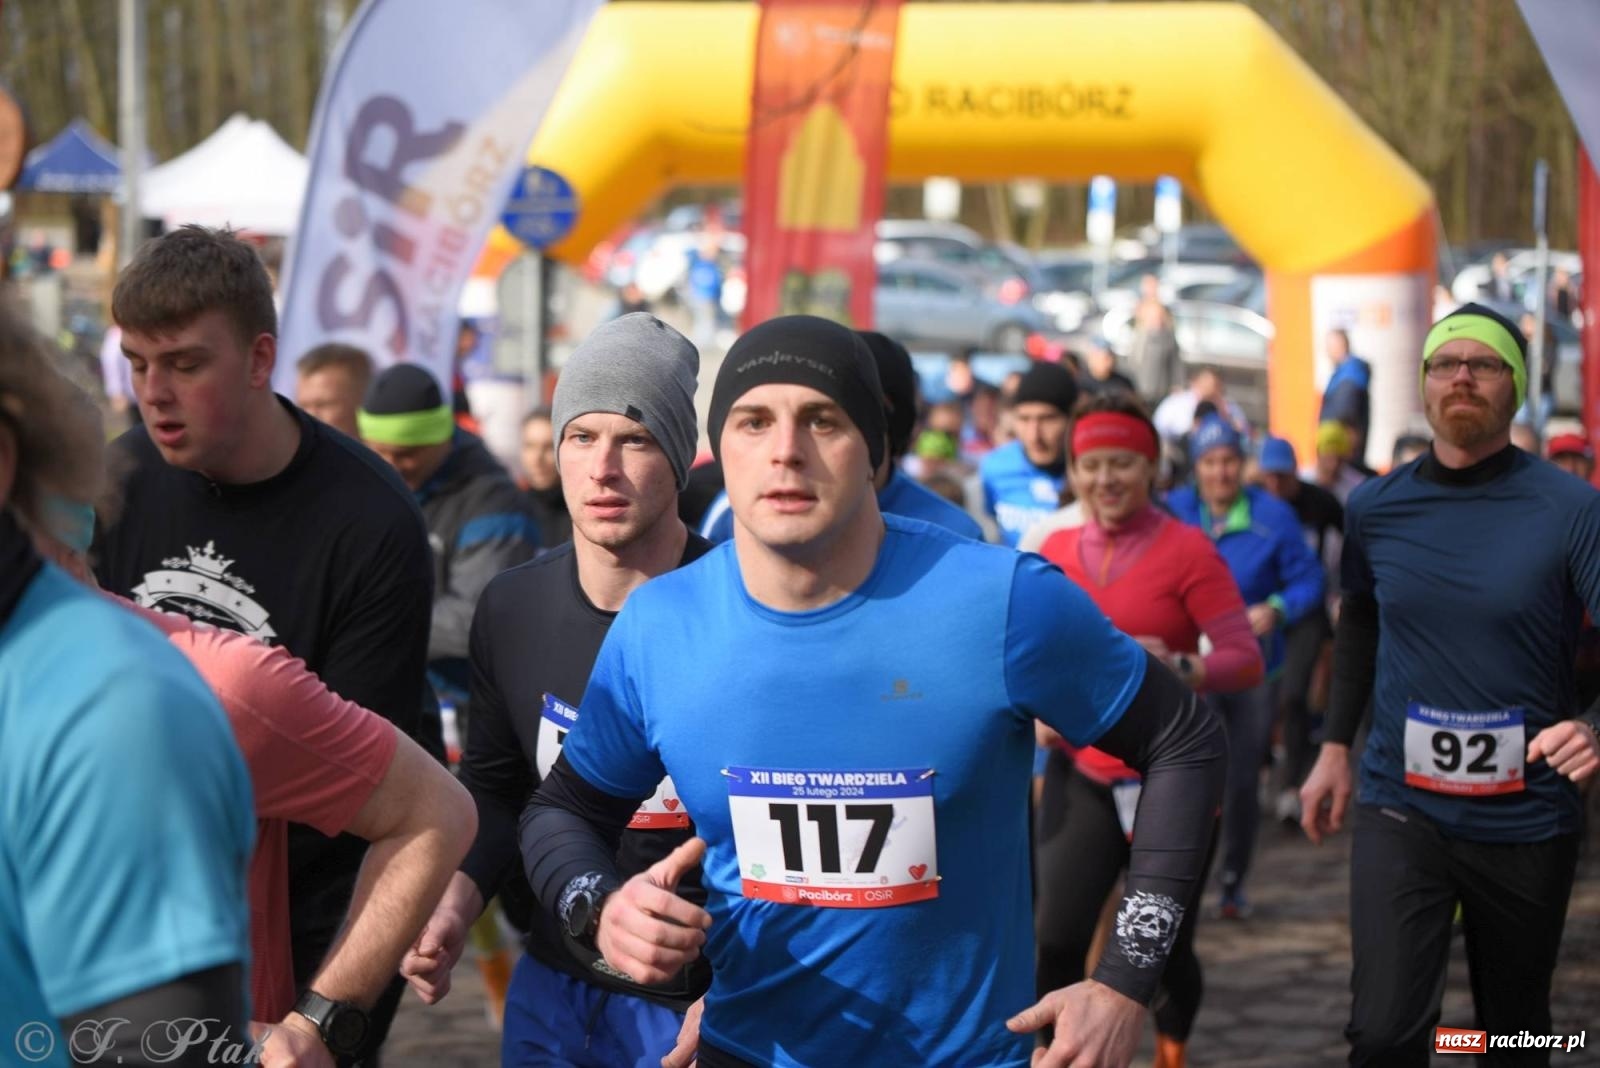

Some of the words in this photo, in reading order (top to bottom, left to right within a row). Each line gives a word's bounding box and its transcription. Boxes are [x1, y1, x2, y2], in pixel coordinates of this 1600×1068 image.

[925, 77, 1136, 120] RACIBÓRZ
[1431, 731, 1498, 774] 92
[751, 771, 769, 785] XII
[772, 772, 806, 785] BIEG
[807, 772, 908, 786] TWARDZIELA
[792, 786, 804, 795] 25
[806, 786, 838, 798] lutego
[839, 786, 864, 796] 2024
[768, 803, 895, 873] 117
[798, 888, 853, 901] Racibórz
[864, 889, 894, 901] OSiR
